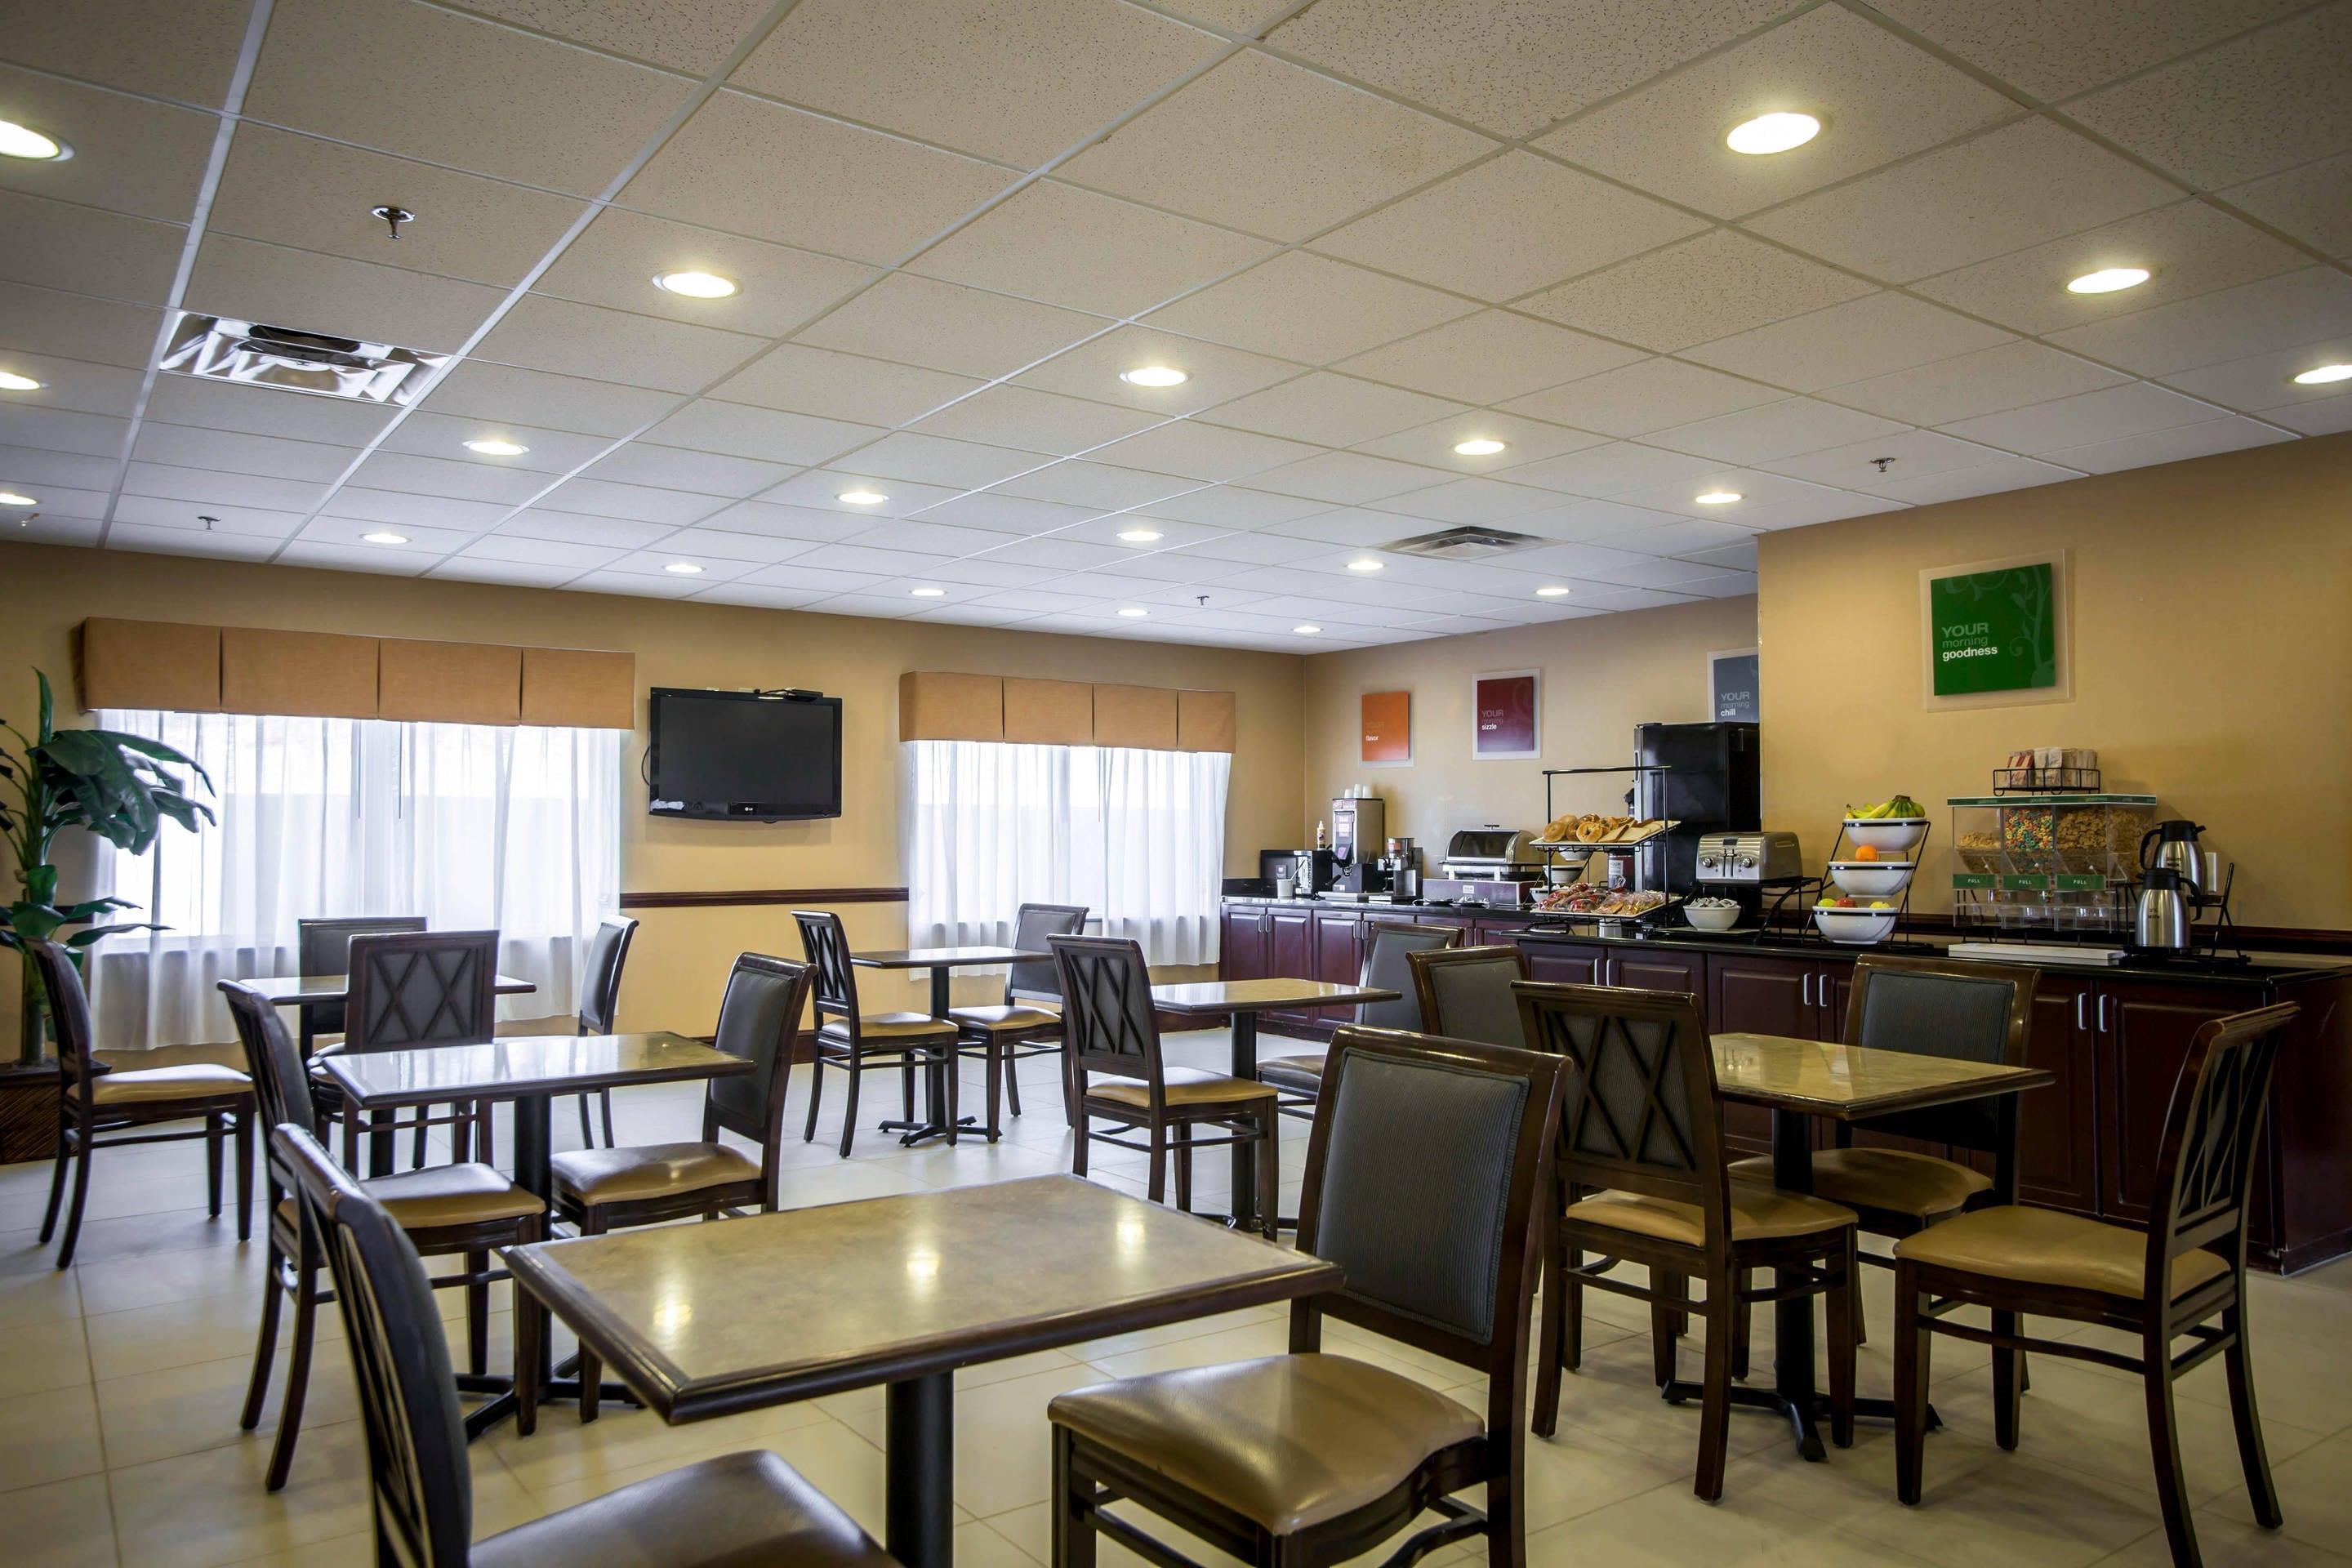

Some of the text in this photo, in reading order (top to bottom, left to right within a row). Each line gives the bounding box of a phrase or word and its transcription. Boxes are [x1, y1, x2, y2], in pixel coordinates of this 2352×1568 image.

[1942, 623, 1989, 637] YOUR
[1942, 636, 1989, 648] morning
[1943, 647, 1998, 662] goodness
[1721, 692, 1749, 701] YOUR
[1481, 709, 1503, 717] YOUR
[1481, 723, 1497, 731] sizzle
